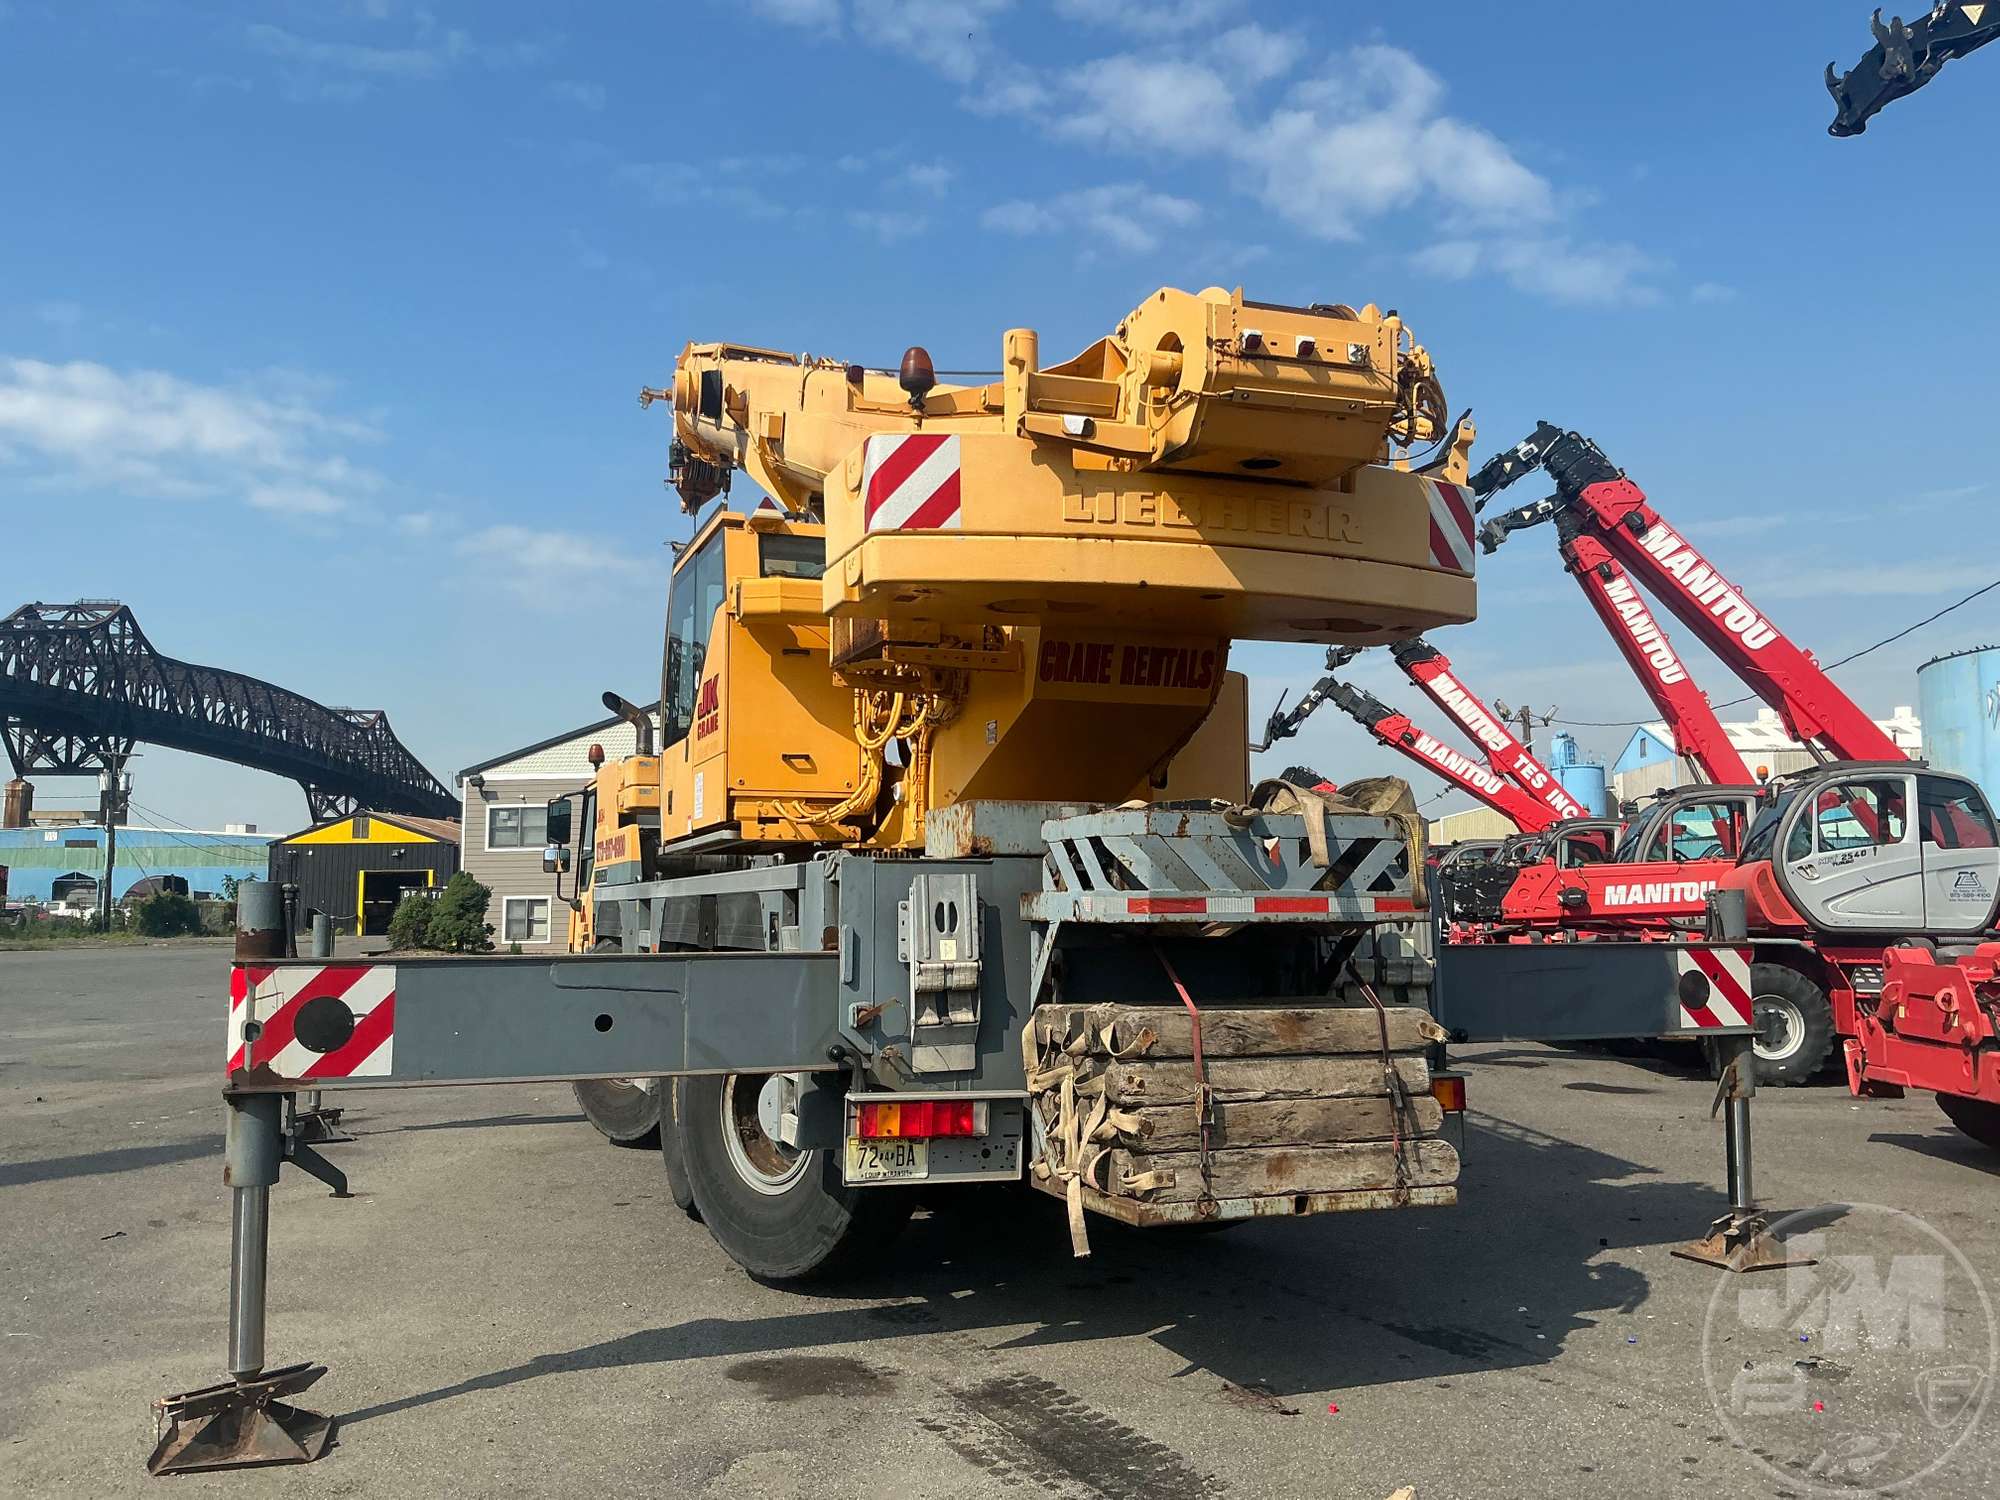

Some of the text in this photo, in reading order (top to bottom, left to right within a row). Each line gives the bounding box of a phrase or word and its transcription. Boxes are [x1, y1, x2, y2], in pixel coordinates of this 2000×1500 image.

[1062, 488, 1364, 544] LIEBHERR
[1637, 521, 1780, 650] MANITOU
[1603, 576, 1688, 685] MANITOU
[1039, 640, 1215, 690] CRANE RENTALS
[698, 673, 719, 720] JK
[698, 712, 719, 741] CRANE
[1427, 672, 1579, 819] MANITOU TES INC
[1414, 735, 1505, 795] MANITOU
[1604, 881, 1716, 905] MANITOU
